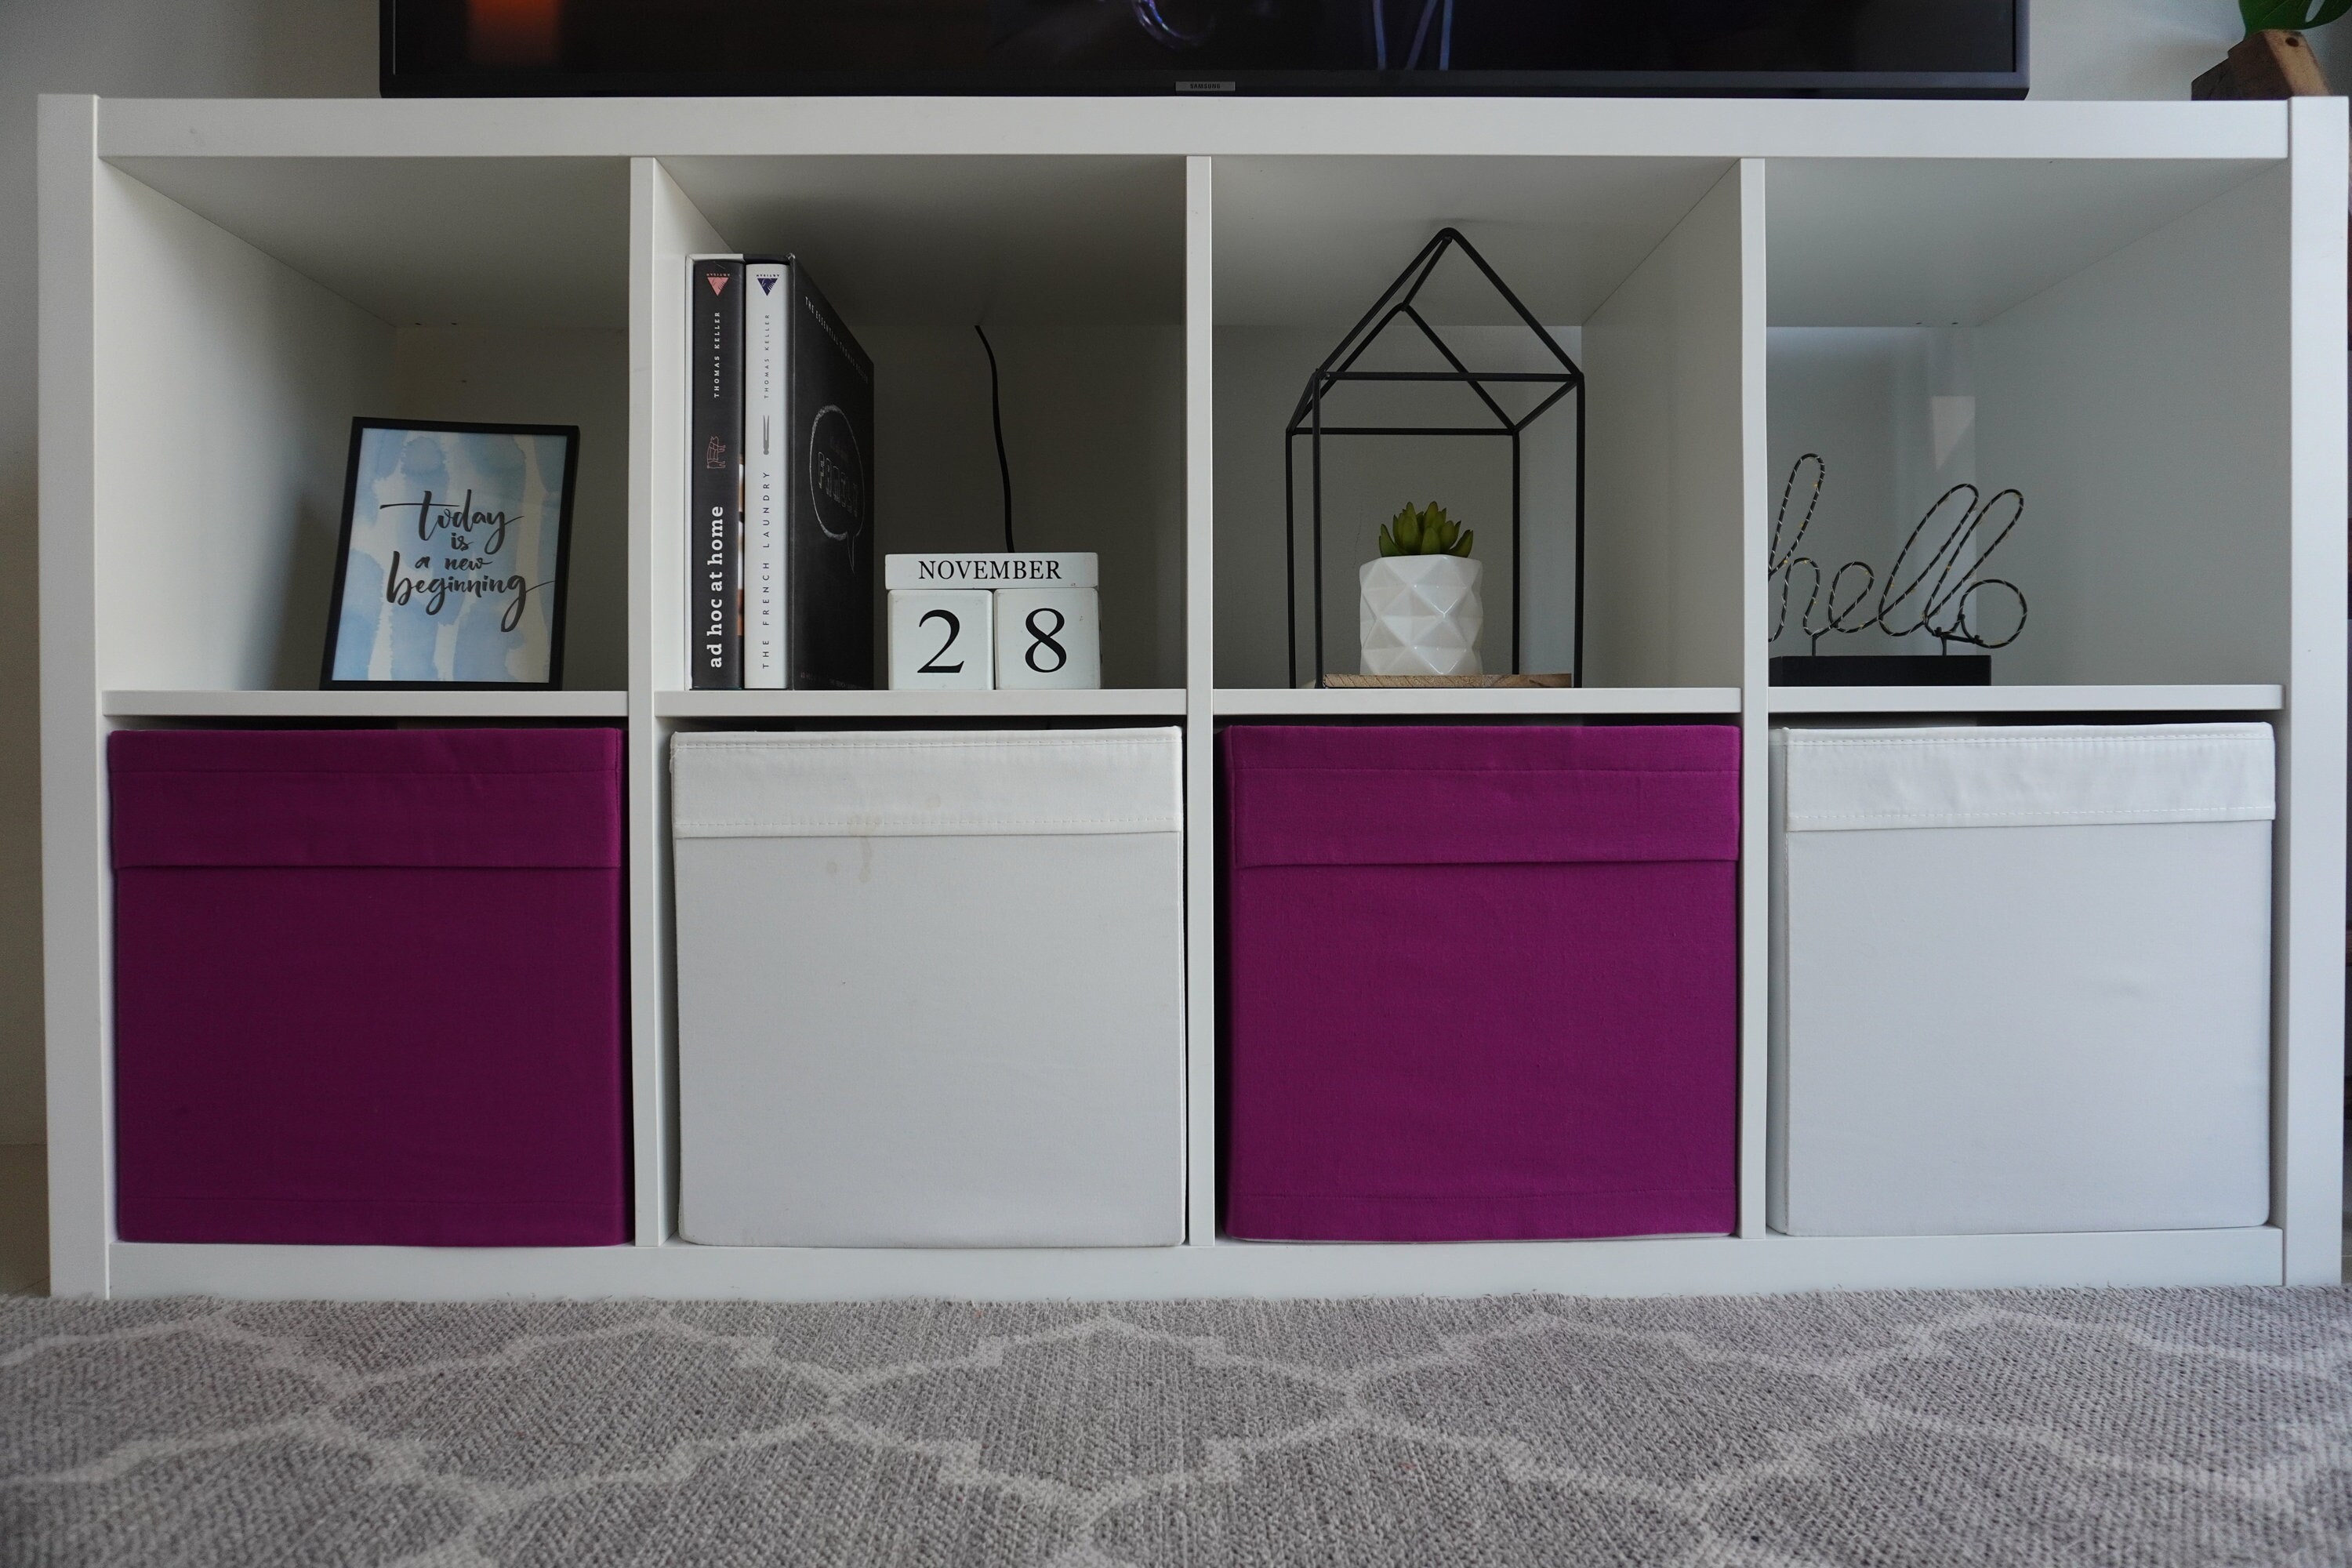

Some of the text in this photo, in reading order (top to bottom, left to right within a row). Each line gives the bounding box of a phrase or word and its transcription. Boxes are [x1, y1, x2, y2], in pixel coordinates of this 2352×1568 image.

[379, 488, 525, 555] today
[450, 532, 474, 552] is
[762, 472, 771, 548] LAUNDRY
[414, 555, 494, 571] a new
[918, 560, 1063, 580] NOVEMBER
[1768, 452, 2028, 649] hello
[385, 550, 557, 633] beginning
[706, 506, 724, 669] ad hoc at home
